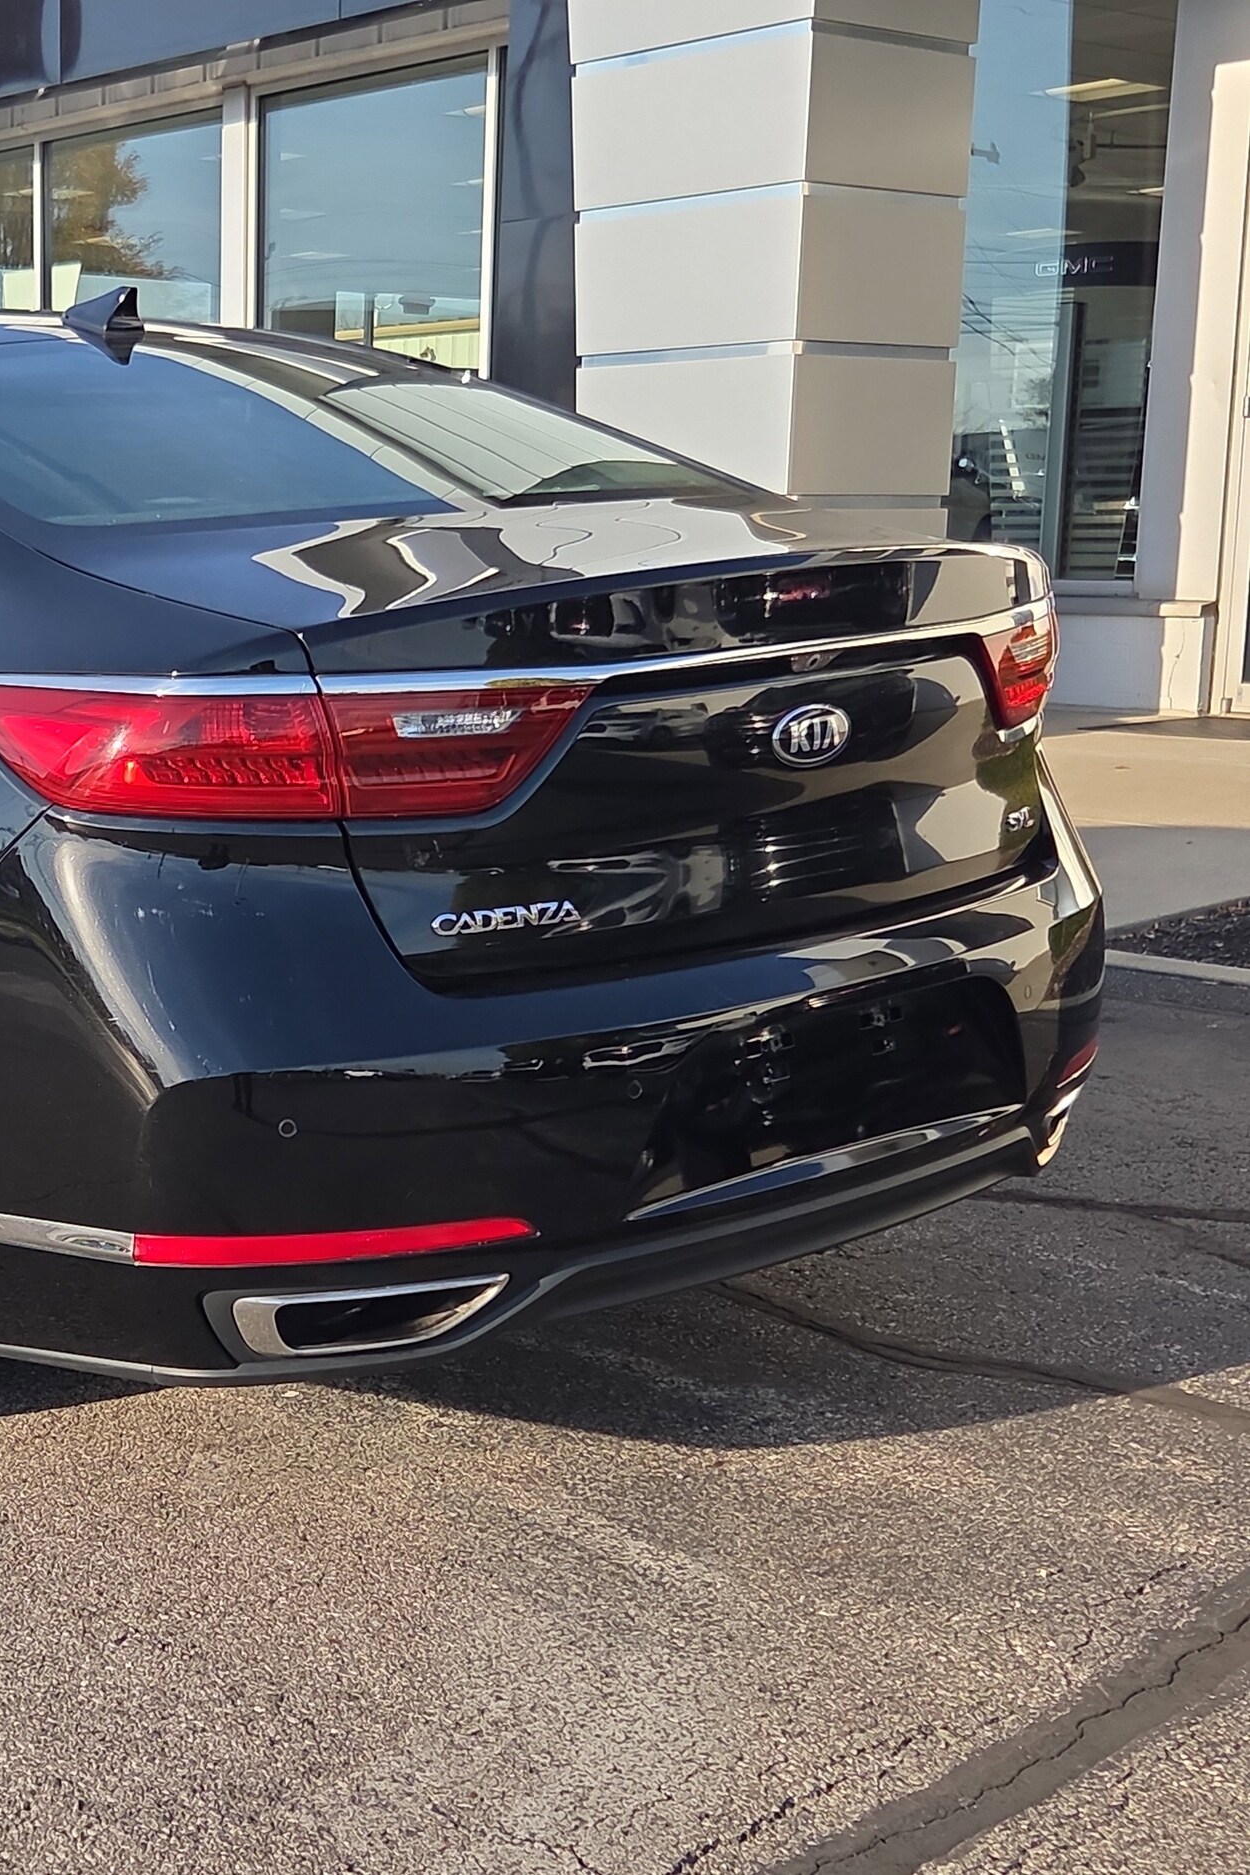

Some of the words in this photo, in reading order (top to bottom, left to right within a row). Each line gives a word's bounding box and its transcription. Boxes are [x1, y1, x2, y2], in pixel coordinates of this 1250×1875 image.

[1034, 256, 1114, 277] GMC
[788, 714, 841, 754] KIA
[430, 900, 583, 936] CADENZA
